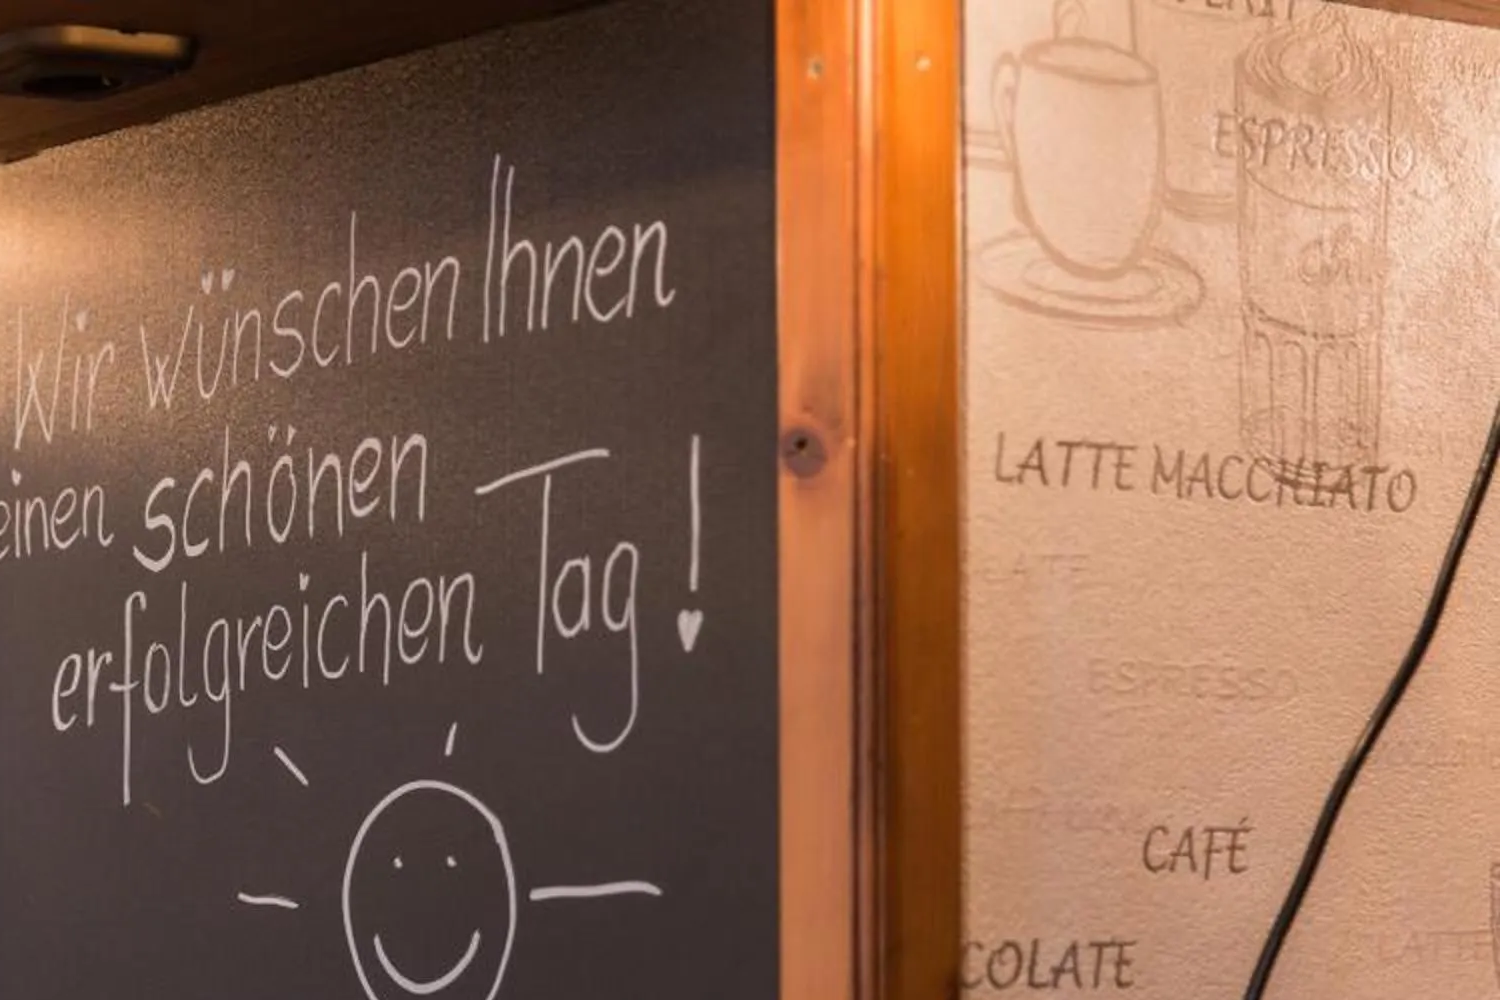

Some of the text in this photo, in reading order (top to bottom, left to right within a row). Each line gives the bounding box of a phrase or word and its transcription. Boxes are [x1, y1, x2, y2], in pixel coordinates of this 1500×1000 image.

[1211, 109, 1416, 181] ESPRESSO
[13, 153, 677, 450] Wir wünschen Ihnen
[133, 424, 429, 572] schönen
[994, 432, 1418, 514] LATTE MACCHIATO
[51, 550, 485, 807] erfolgreichen
[1142, 818, 1255, 880] CAFÉ
